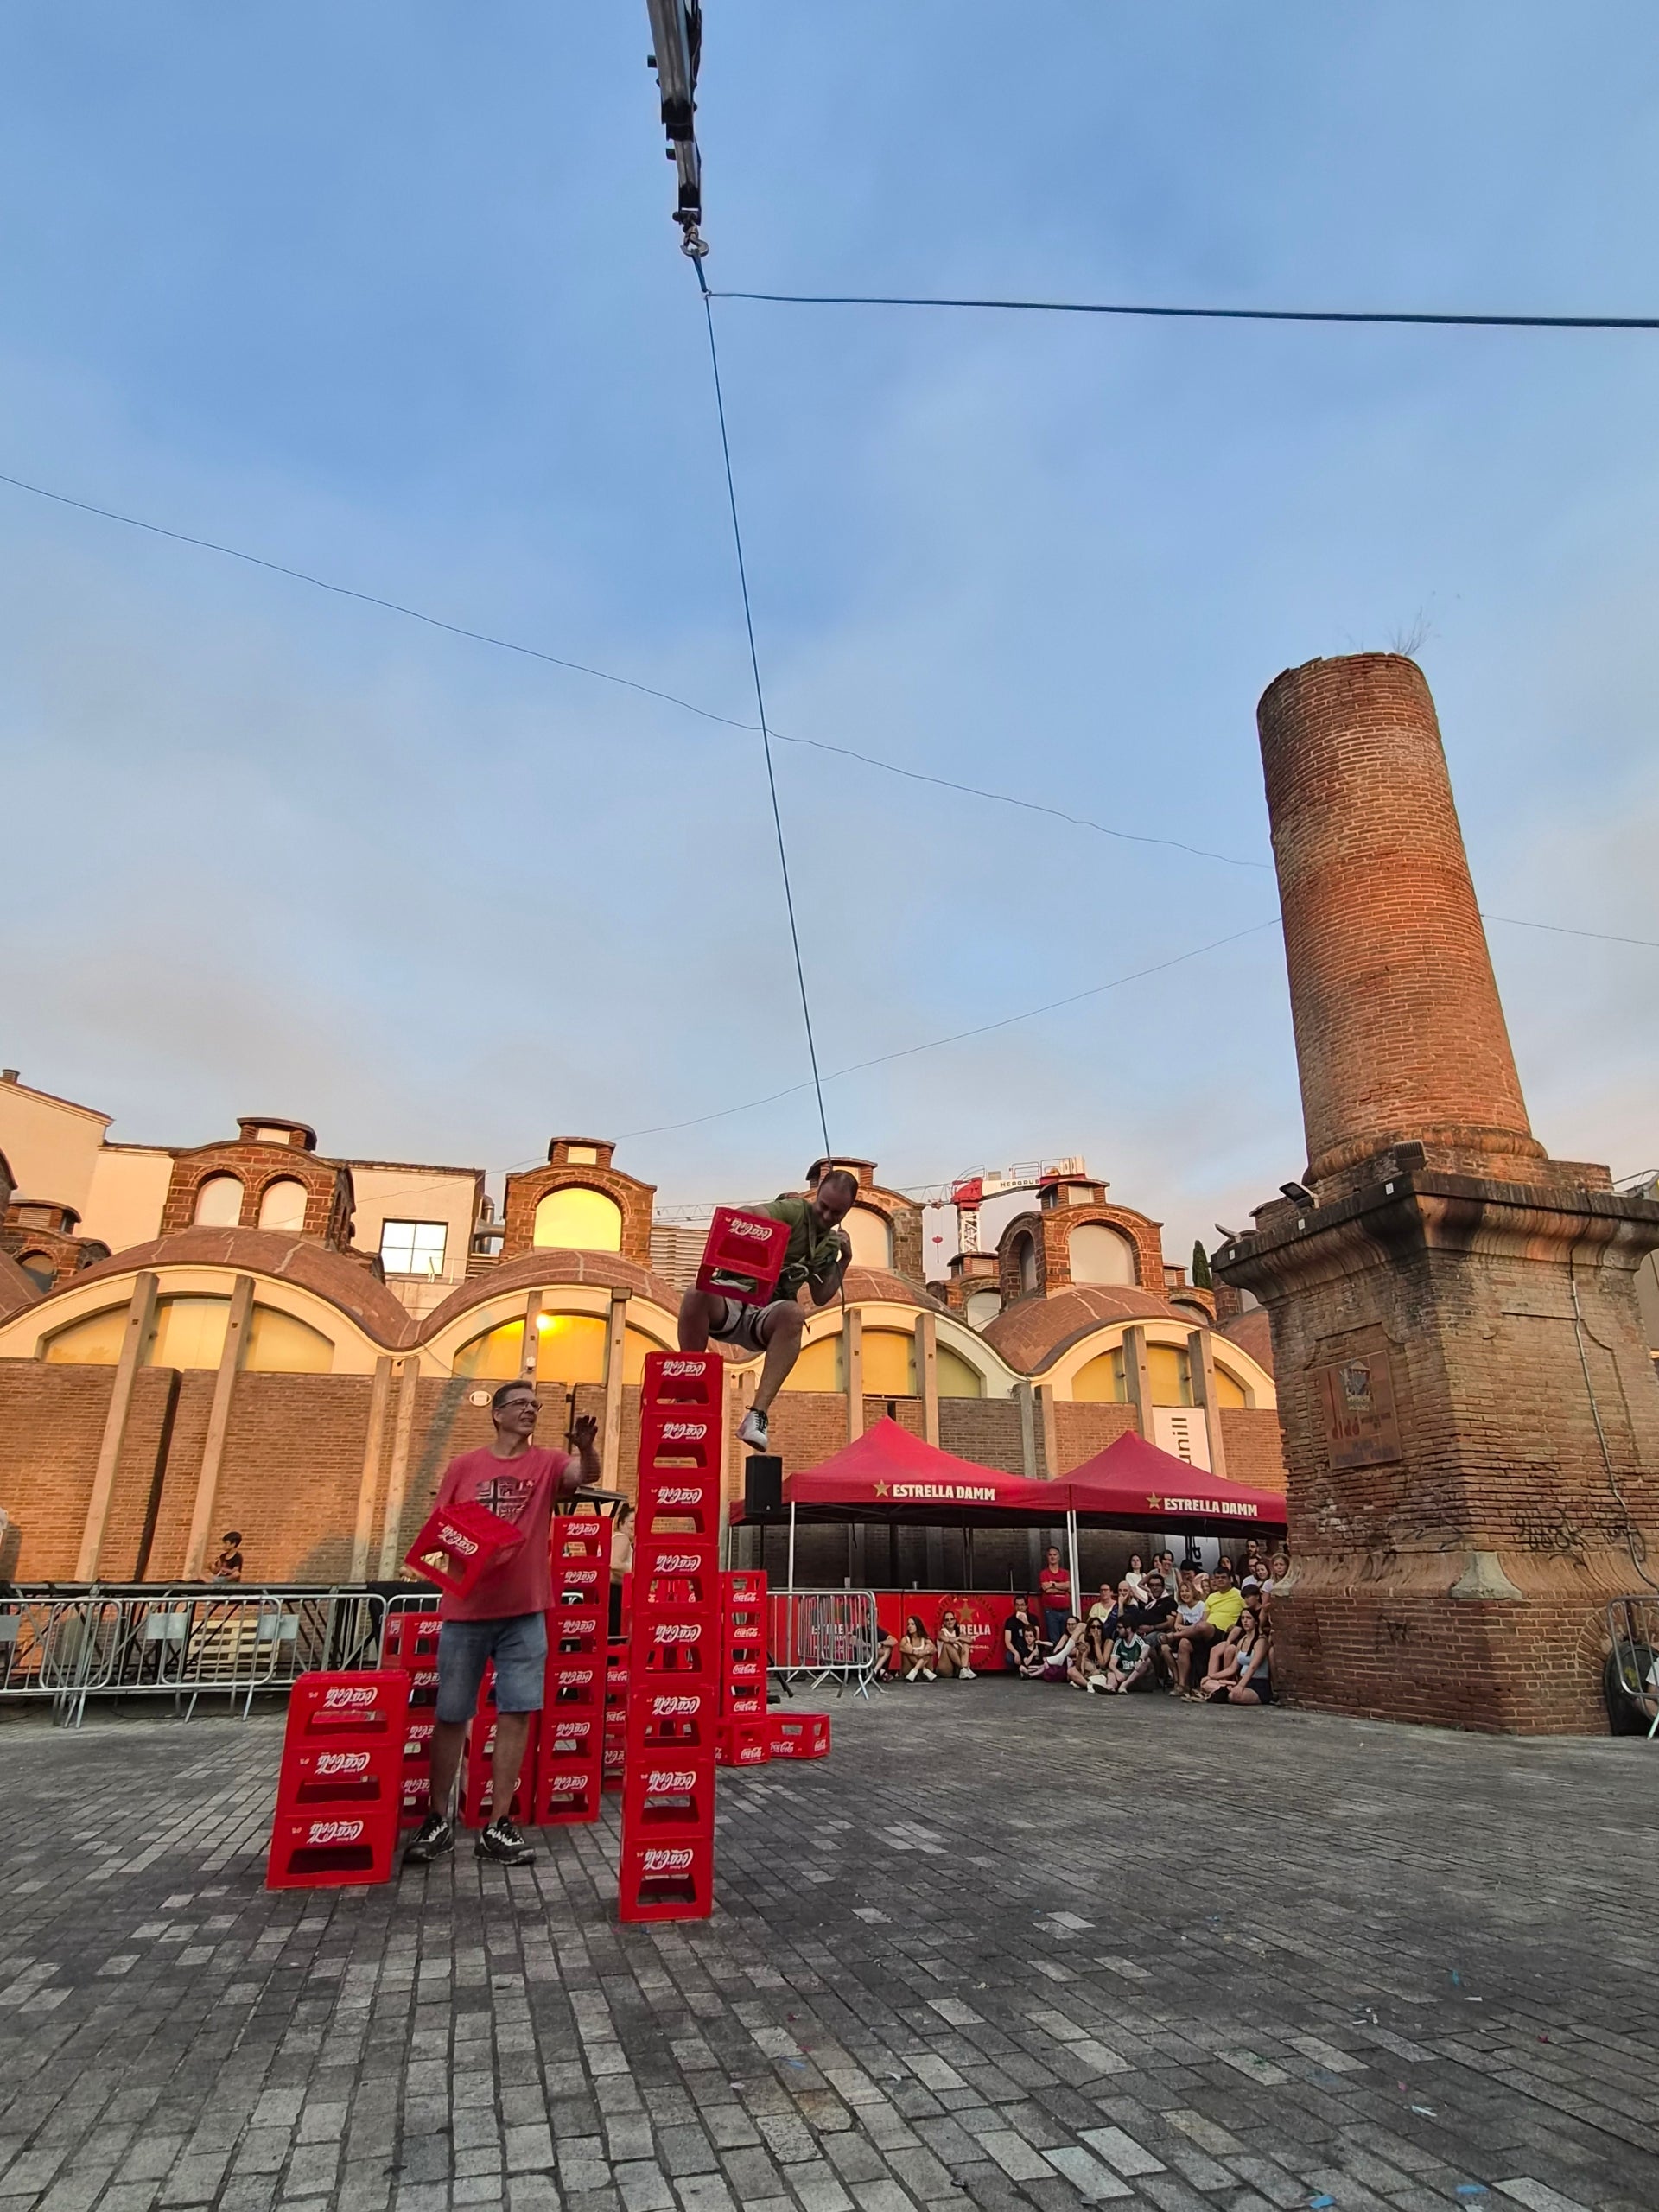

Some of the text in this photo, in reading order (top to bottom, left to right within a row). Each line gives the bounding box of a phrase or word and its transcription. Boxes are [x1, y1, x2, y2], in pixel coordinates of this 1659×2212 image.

[893, 1484, 995, 1501] ESTRELLA DAMM
[1164, 1497, 1258, 1516] ESTRELLA DAMM
[959, 1624, 991, 1635] RELLA
